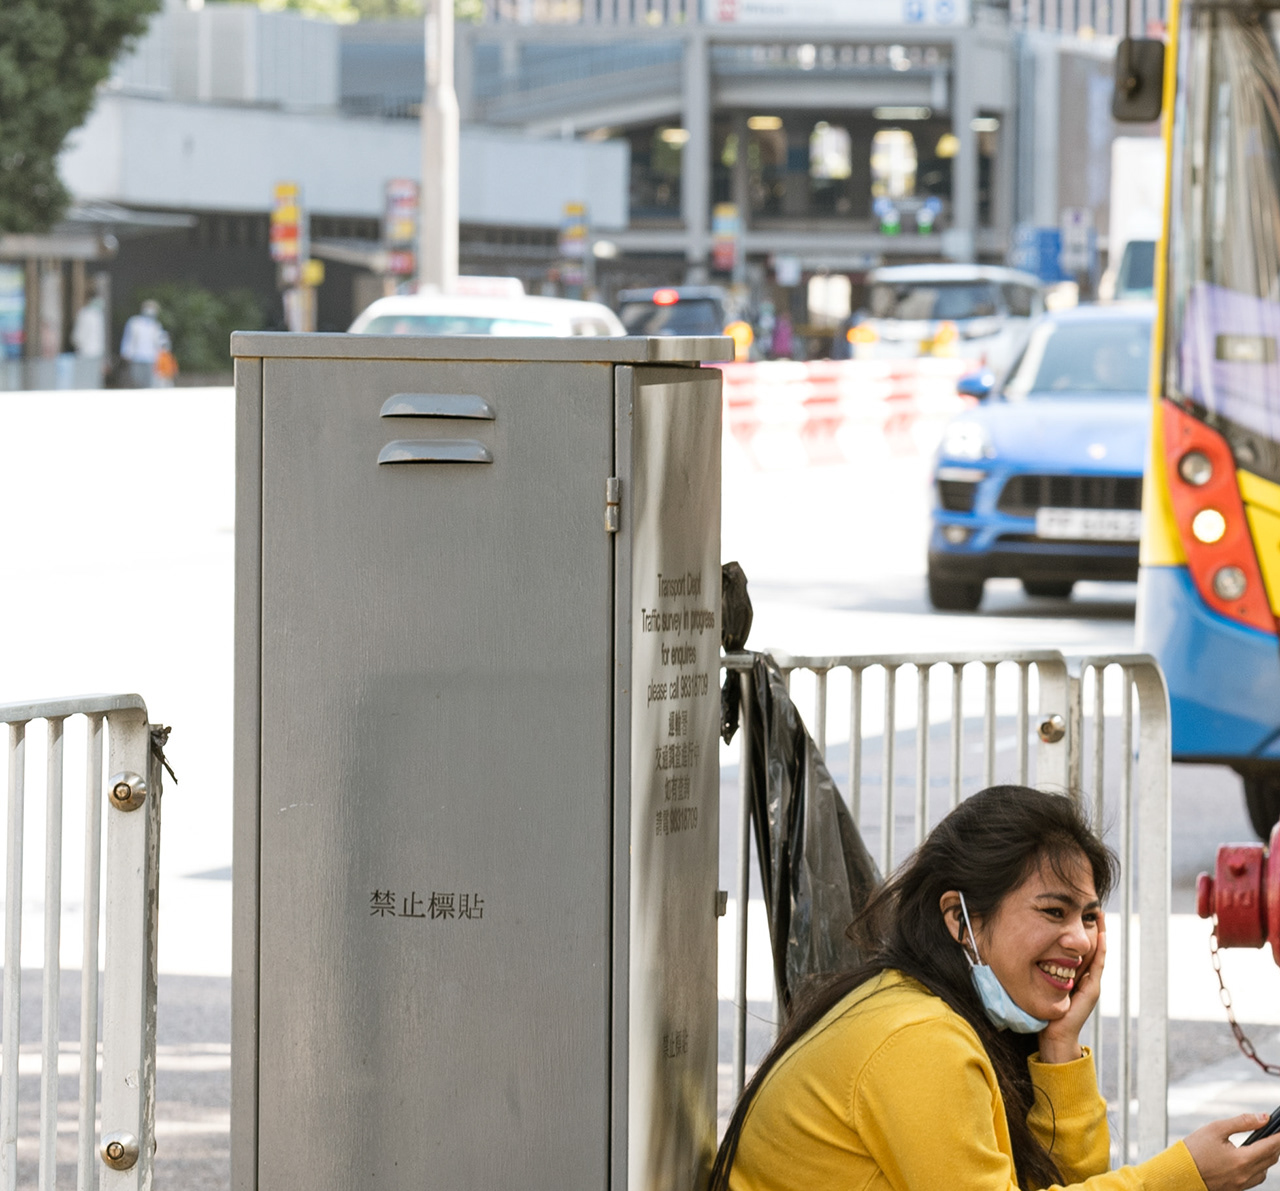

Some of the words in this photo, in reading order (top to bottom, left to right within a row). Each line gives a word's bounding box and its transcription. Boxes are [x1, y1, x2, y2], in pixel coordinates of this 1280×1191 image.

[657, 573, 685, 602] Transport
[641, 608, 661, 633] Traffic
[661, 610, 682, 637] survey
[683, 606, 689, 631] in
[690, 609, 715, 635] progress
[661, 642, 670, 666] for
[647, 678, 668, 708] please
[669, 675, 679, 700] call
[369, 889, 485, 920] 禁止標貼
